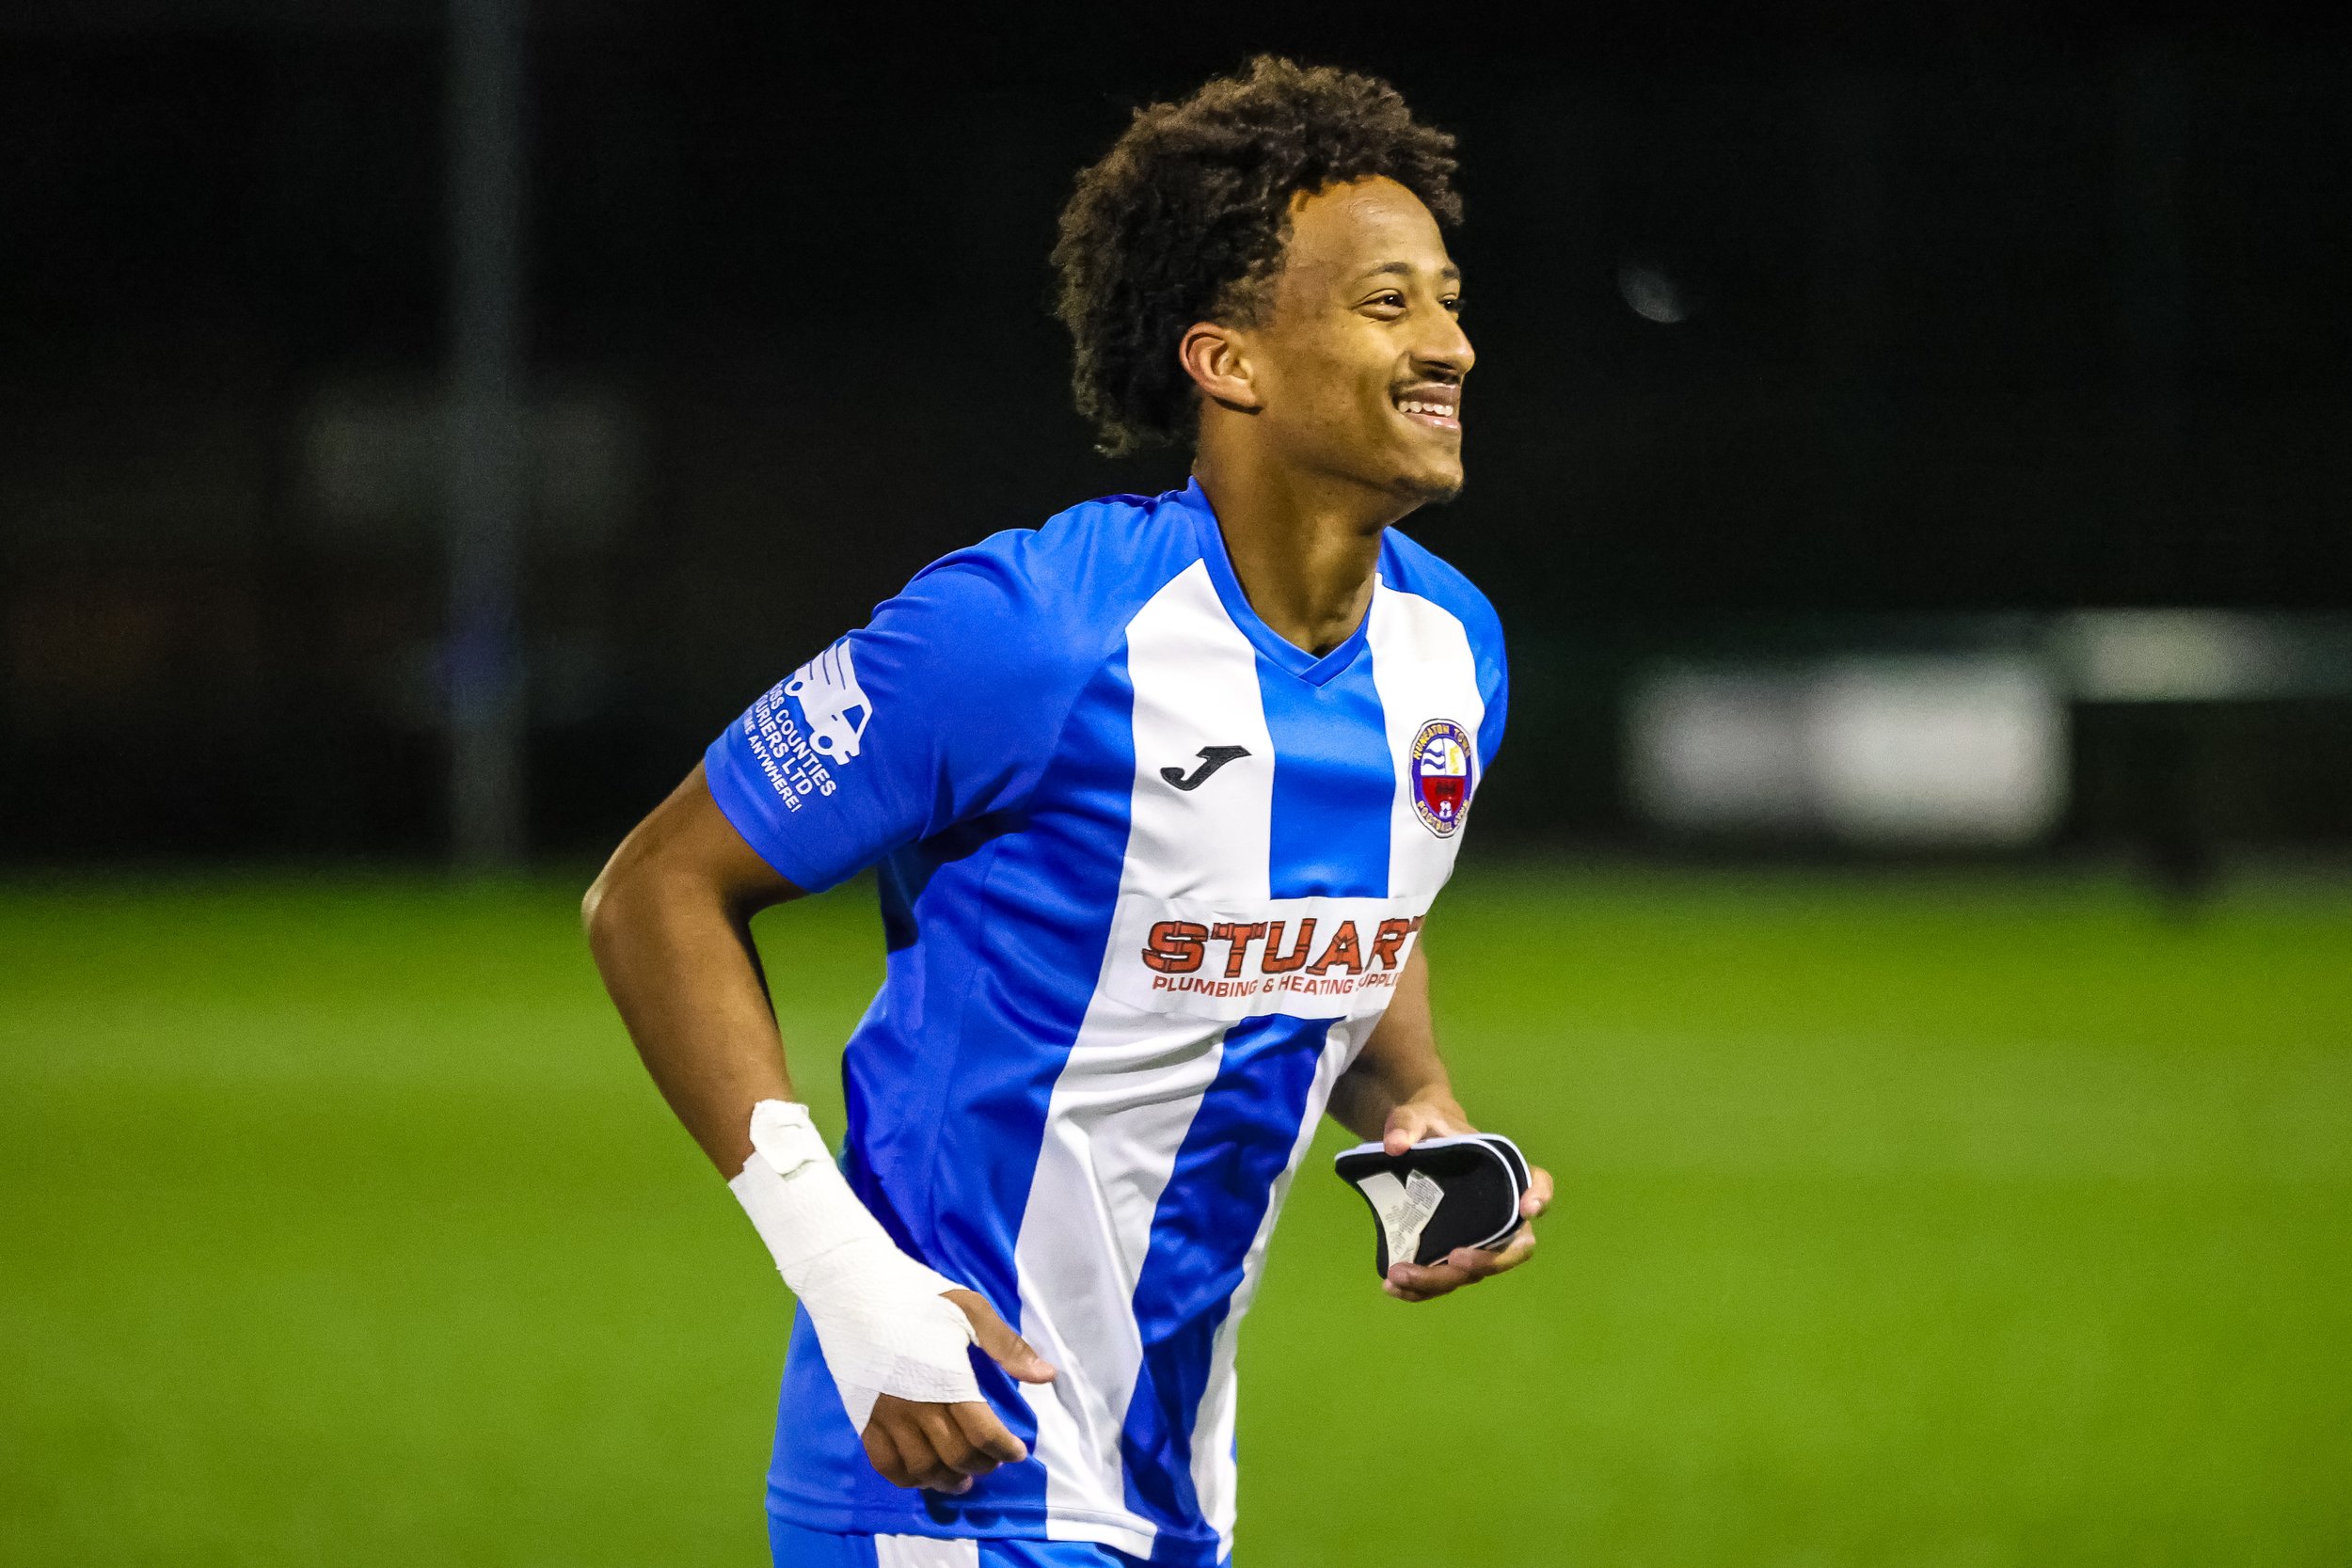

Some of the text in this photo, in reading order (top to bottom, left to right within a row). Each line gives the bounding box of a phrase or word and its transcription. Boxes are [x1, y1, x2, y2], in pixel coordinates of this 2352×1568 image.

[748, 735, 803, 813] ANYWHERE!
[755, 694, 813, 795] URIERS LTD
[775, 709, 836, 797] COUNTIES
[1152, 973, 1399, 998] PLUMBING & HEATING UPPLI
